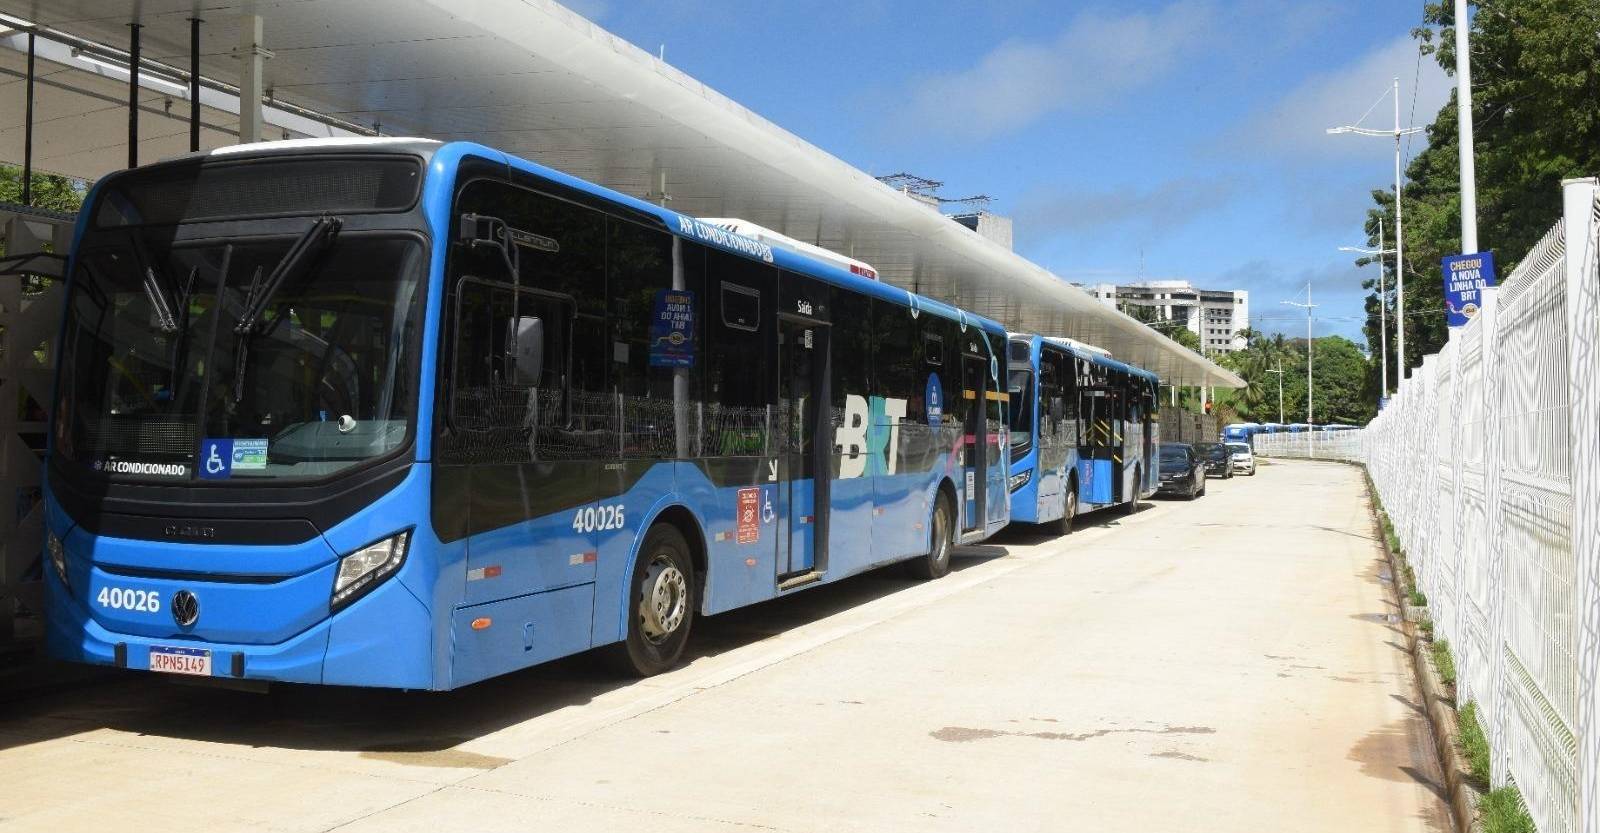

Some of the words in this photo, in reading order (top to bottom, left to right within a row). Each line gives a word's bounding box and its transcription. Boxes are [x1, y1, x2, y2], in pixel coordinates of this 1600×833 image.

[678, 216, 695, 236] AR
[694, 222, 763, 257] CONDICIONADO
[1450, 259, 1481, 271] CHEGOU
[1451, 272, 1458, 282] A
[1459, 269, 1480, 281] NOVA
[1449, 280, 1474, 292] LINHA
[1475, 279, 1487, 289] DO
[1461, 291, 1476, 301] BRT
[836, 394, 907, 479] BRT
[104, 460, 116, 472] AR
[117, 461, 185, 476] CONDICIONADO
[573, 504, 625, 534] 40026
[97, 586, 160, 613] 40026
